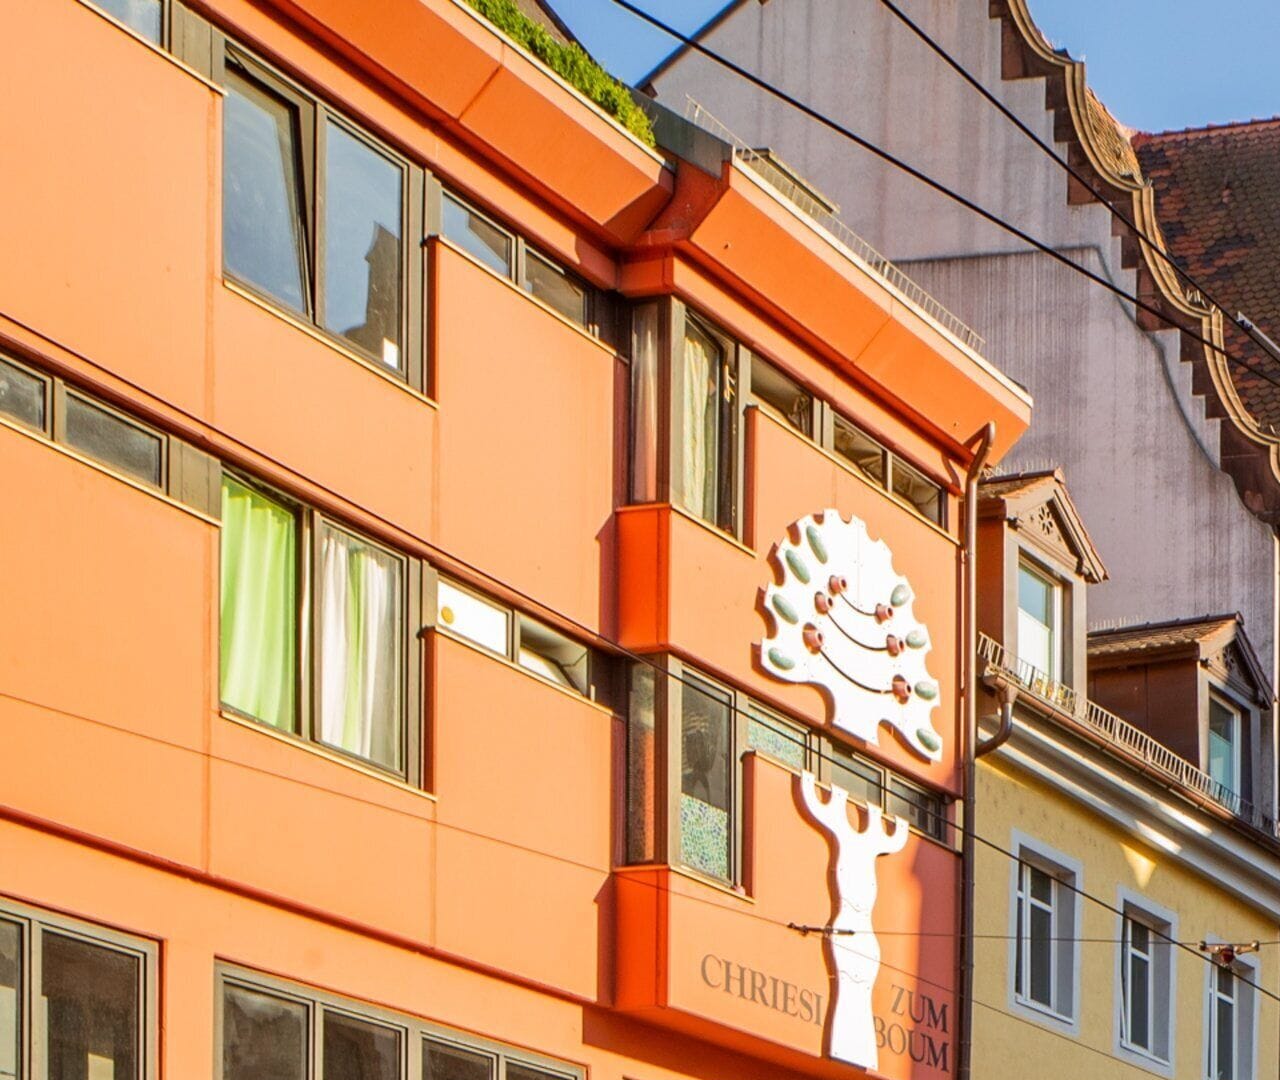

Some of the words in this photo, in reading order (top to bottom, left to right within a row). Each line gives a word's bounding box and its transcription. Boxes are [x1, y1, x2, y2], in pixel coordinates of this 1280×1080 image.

[701, 954, 823, 1026] CHRIESI
[890, 983, 949, 1033] ZUM
[874, 1016, 950, 1073] BOUM
